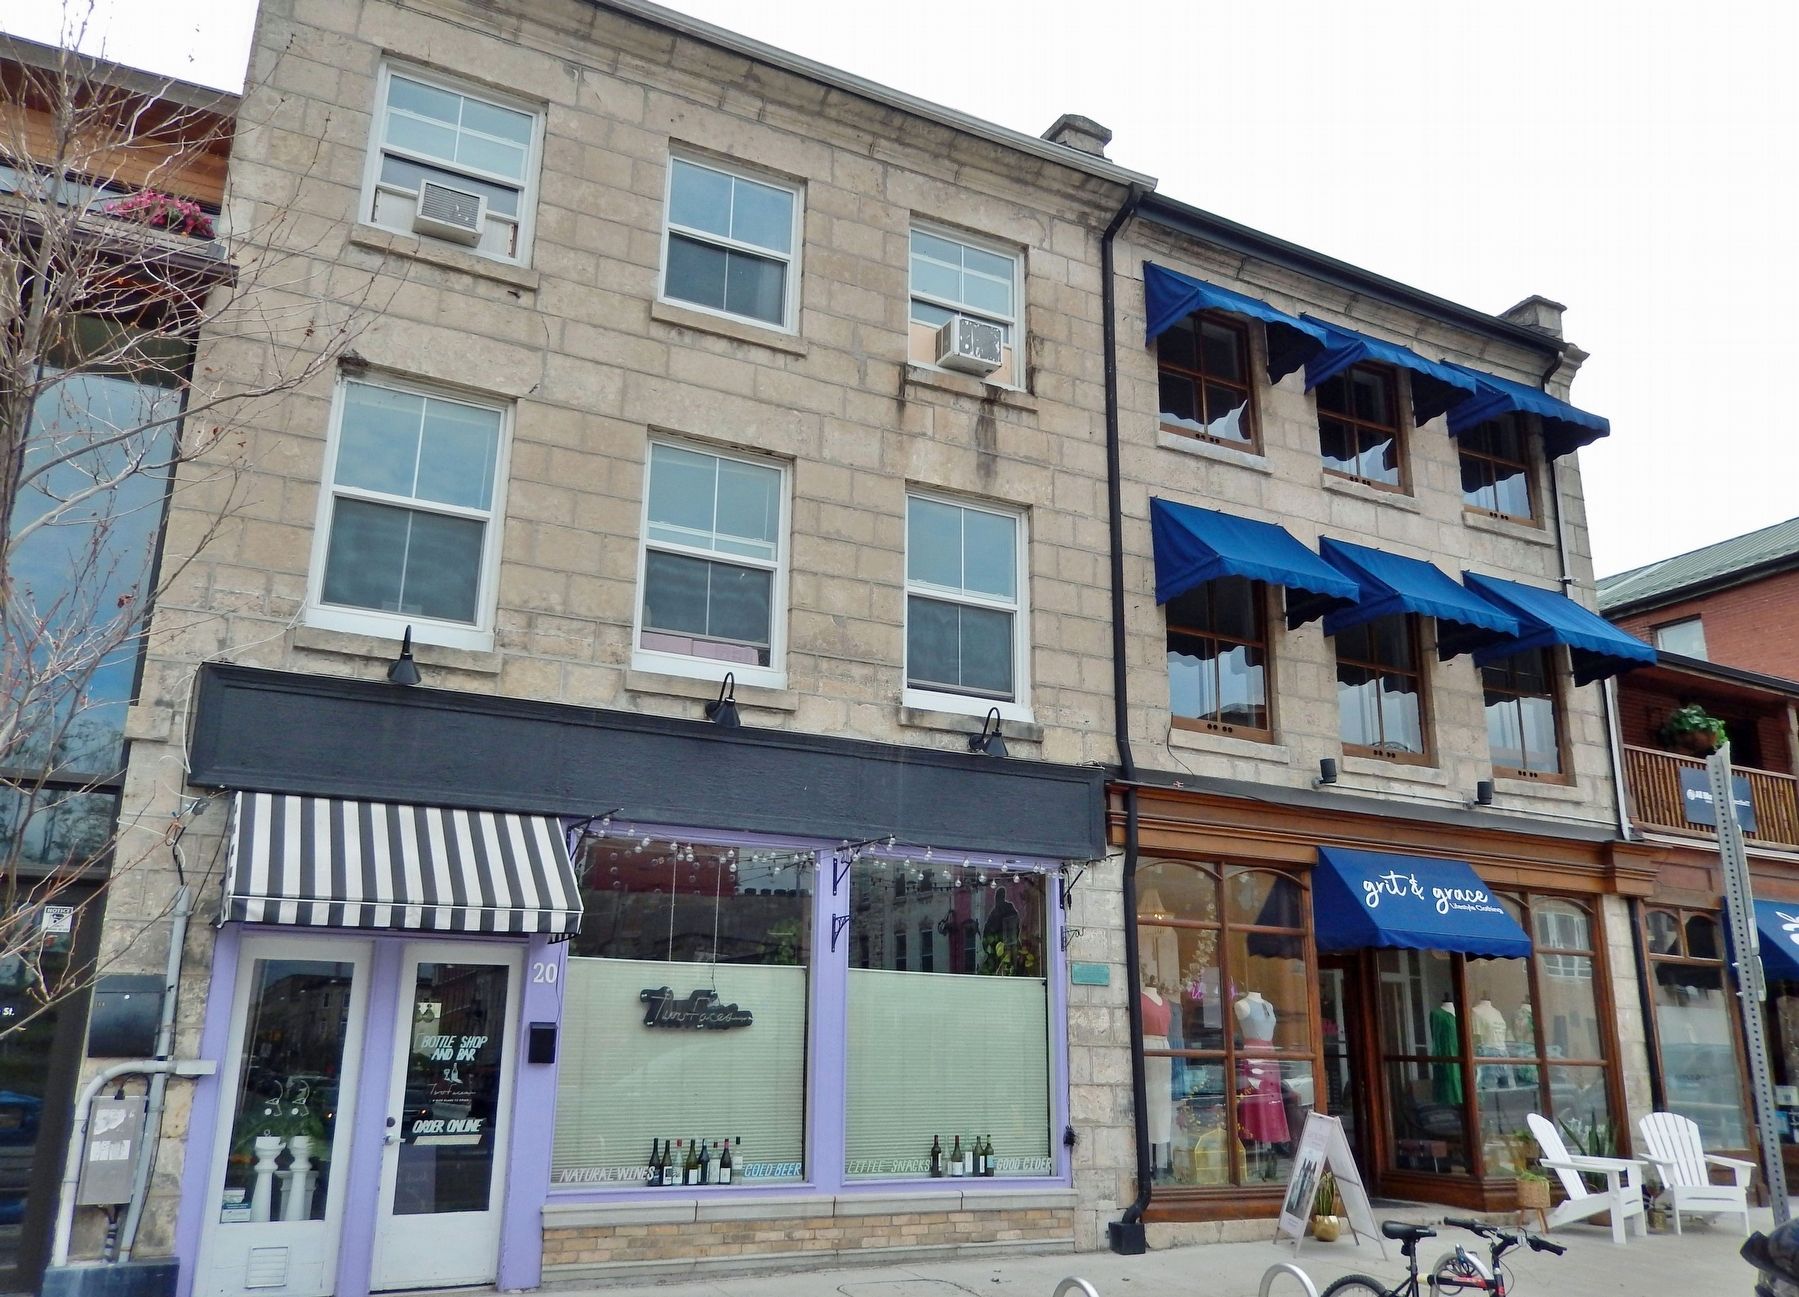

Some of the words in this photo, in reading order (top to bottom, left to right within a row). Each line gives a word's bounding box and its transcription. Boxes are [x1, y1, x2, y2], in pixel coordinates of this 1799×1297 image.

[1363, 870, 1409, 908] grit
[1408, 873, 1425, 900] &
[1432, 887, 1488, 915] grace
[46, 907, 72, 915] NOTICE
[533, 962, 558, 983] 20
[3, 1007, 15, 1016] St.
[422, 1035, 456, 1048] BOTTLE
[461, 1035, 488, 1048] SHOP
[431, 1048, 454, 1060] AND
[456, 1048, 476, 1060] BAR
[412, 1119, 445, 1133] ORDER
[446, 1119, 482, 1133] ONLINE
[744, 1164, 774, 1177] COLD
[773, 1162, 802, 1176] BEER
[890, 1159, 931, 1173] SNACKS
[996, 1158, 1022, 1171] GOOD
[1022, 1157, 1052, 1170] CIDER
[560, 1168, 615, 1181] NATURAL
[616, 1166, 656, 1181] WINES
